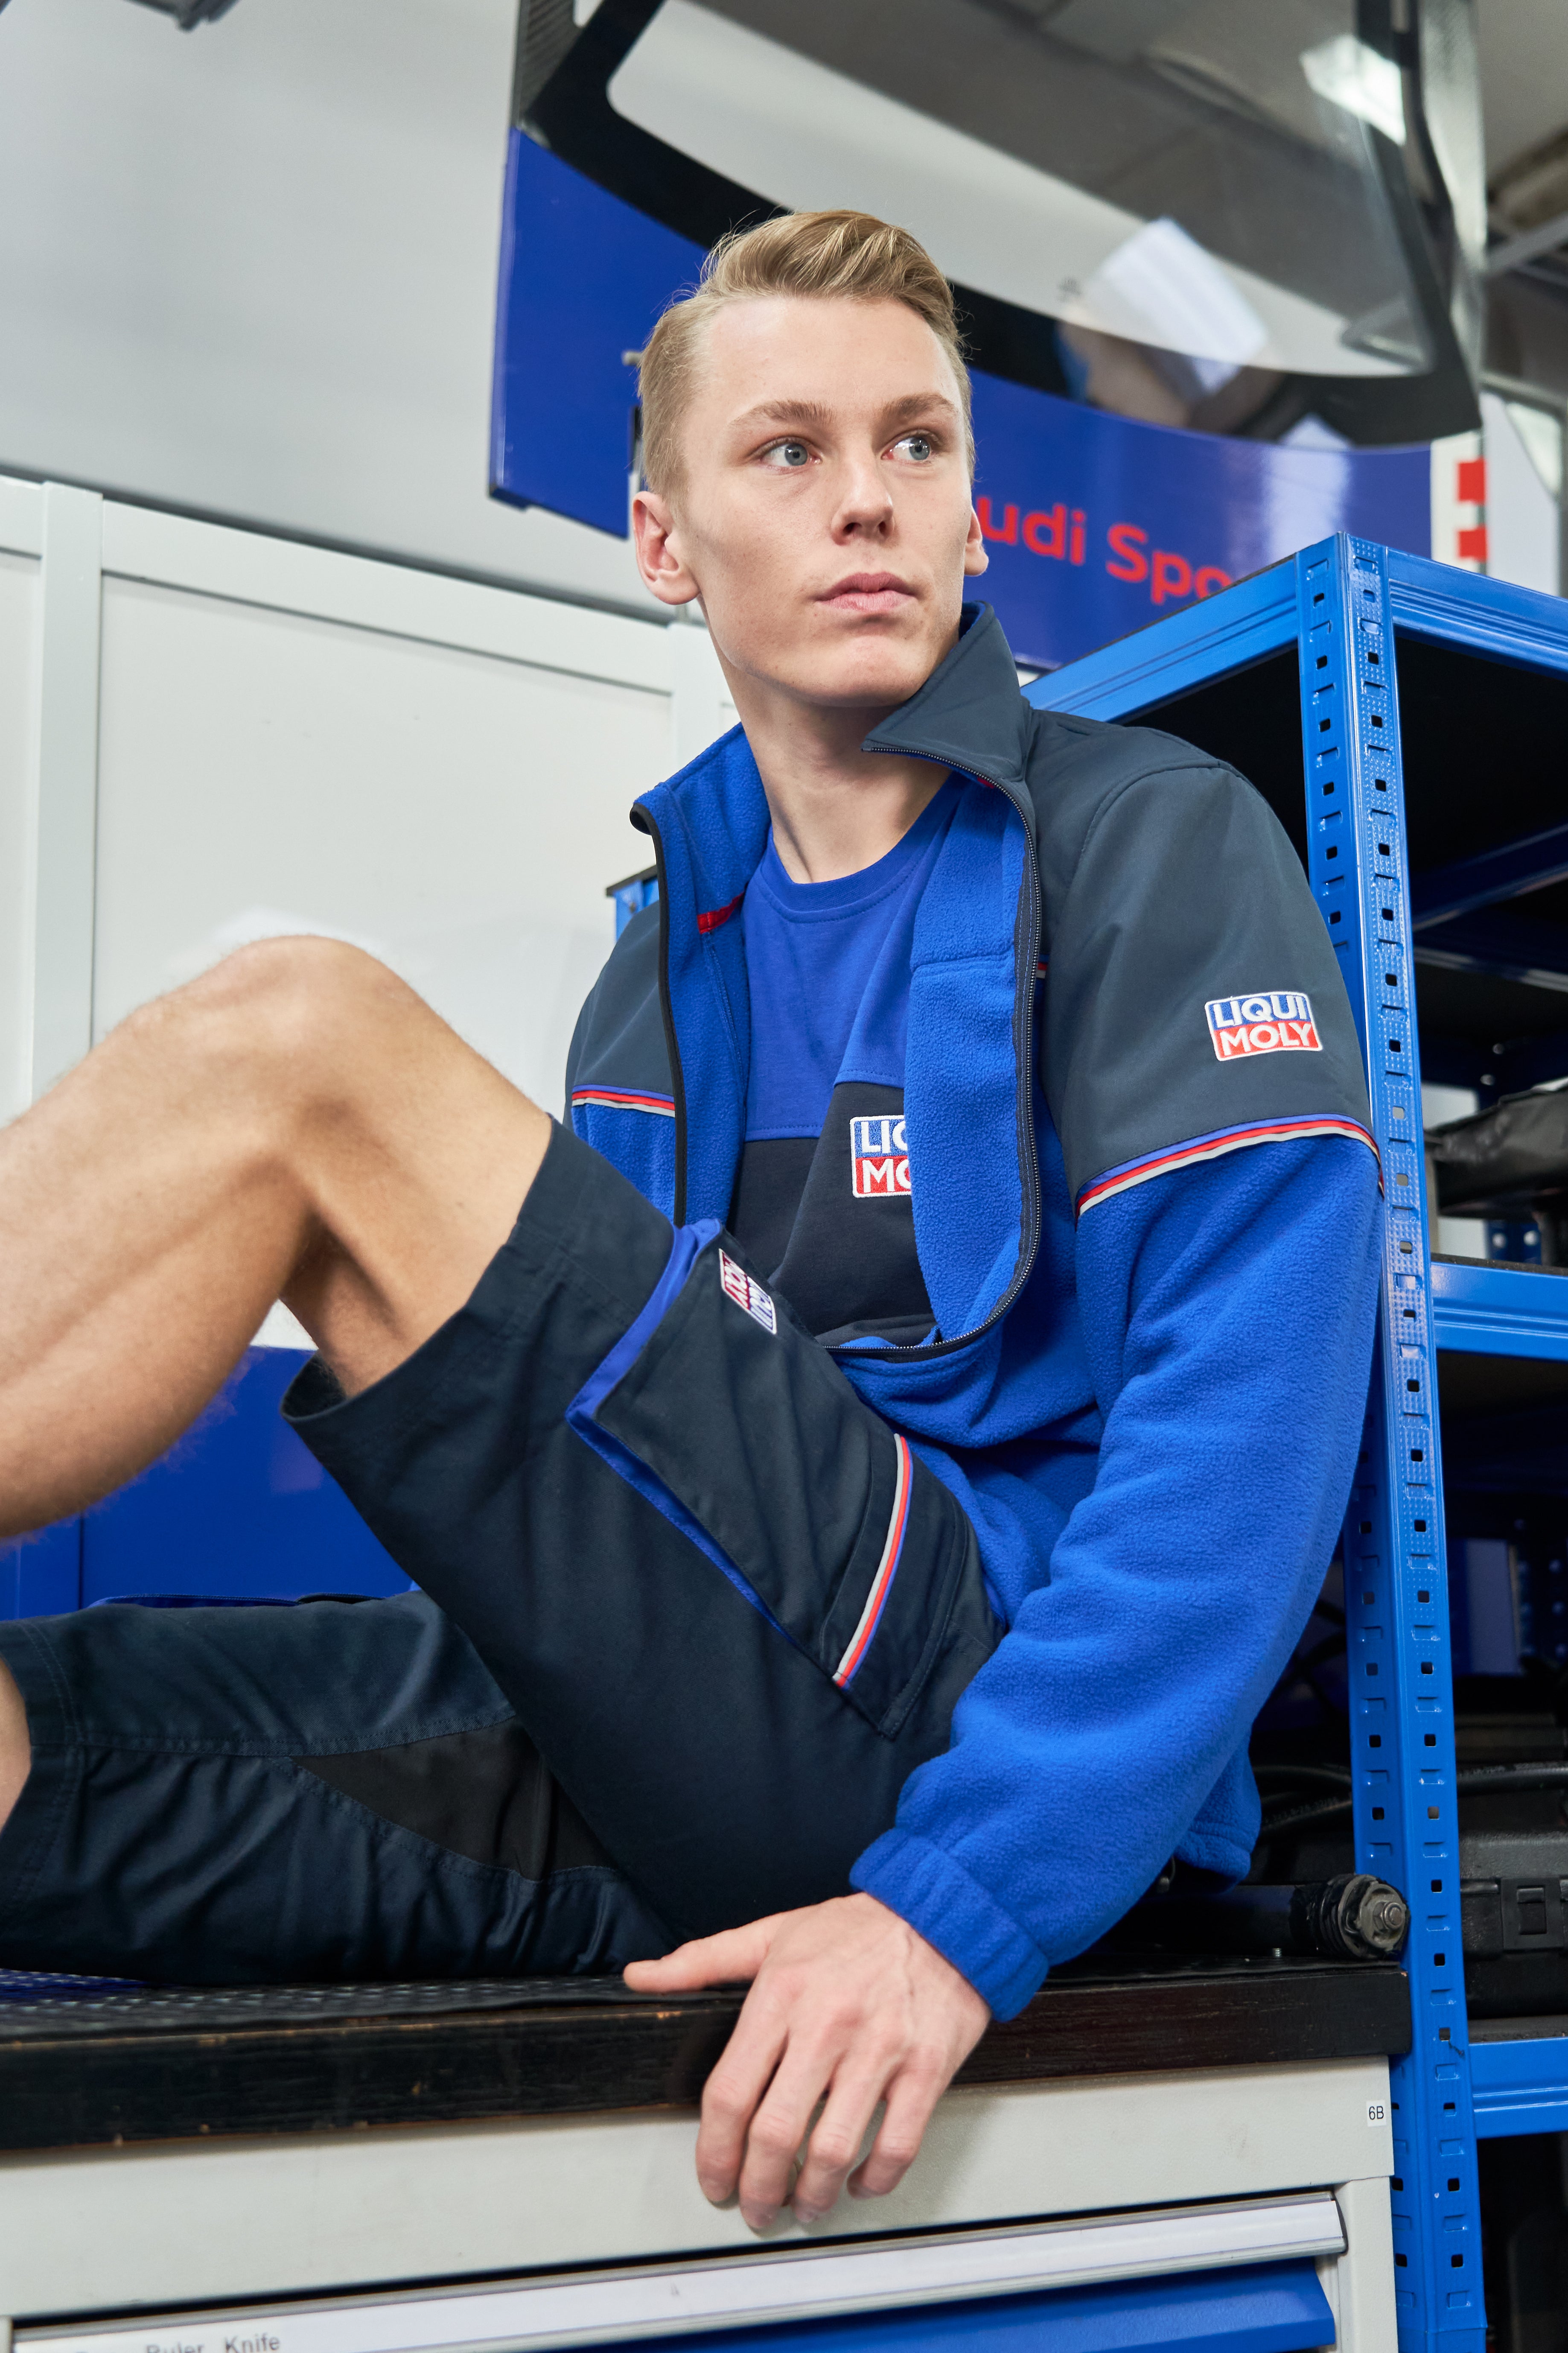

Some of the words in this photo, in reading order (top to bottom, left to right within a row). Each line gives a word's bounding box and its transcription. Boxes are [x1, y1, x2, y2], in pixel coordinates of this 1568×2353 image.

[977, 496, 1085, 565] udi
[1107, 521, 1233, 604] Spo
[1212, 994, 1307, 1028] LIQUI
[1219, 1022, 1312, 1056] MOLY
[1369, 2105, 1384, 2120] 6B
[224, 2332, 280, 2353] Knife
